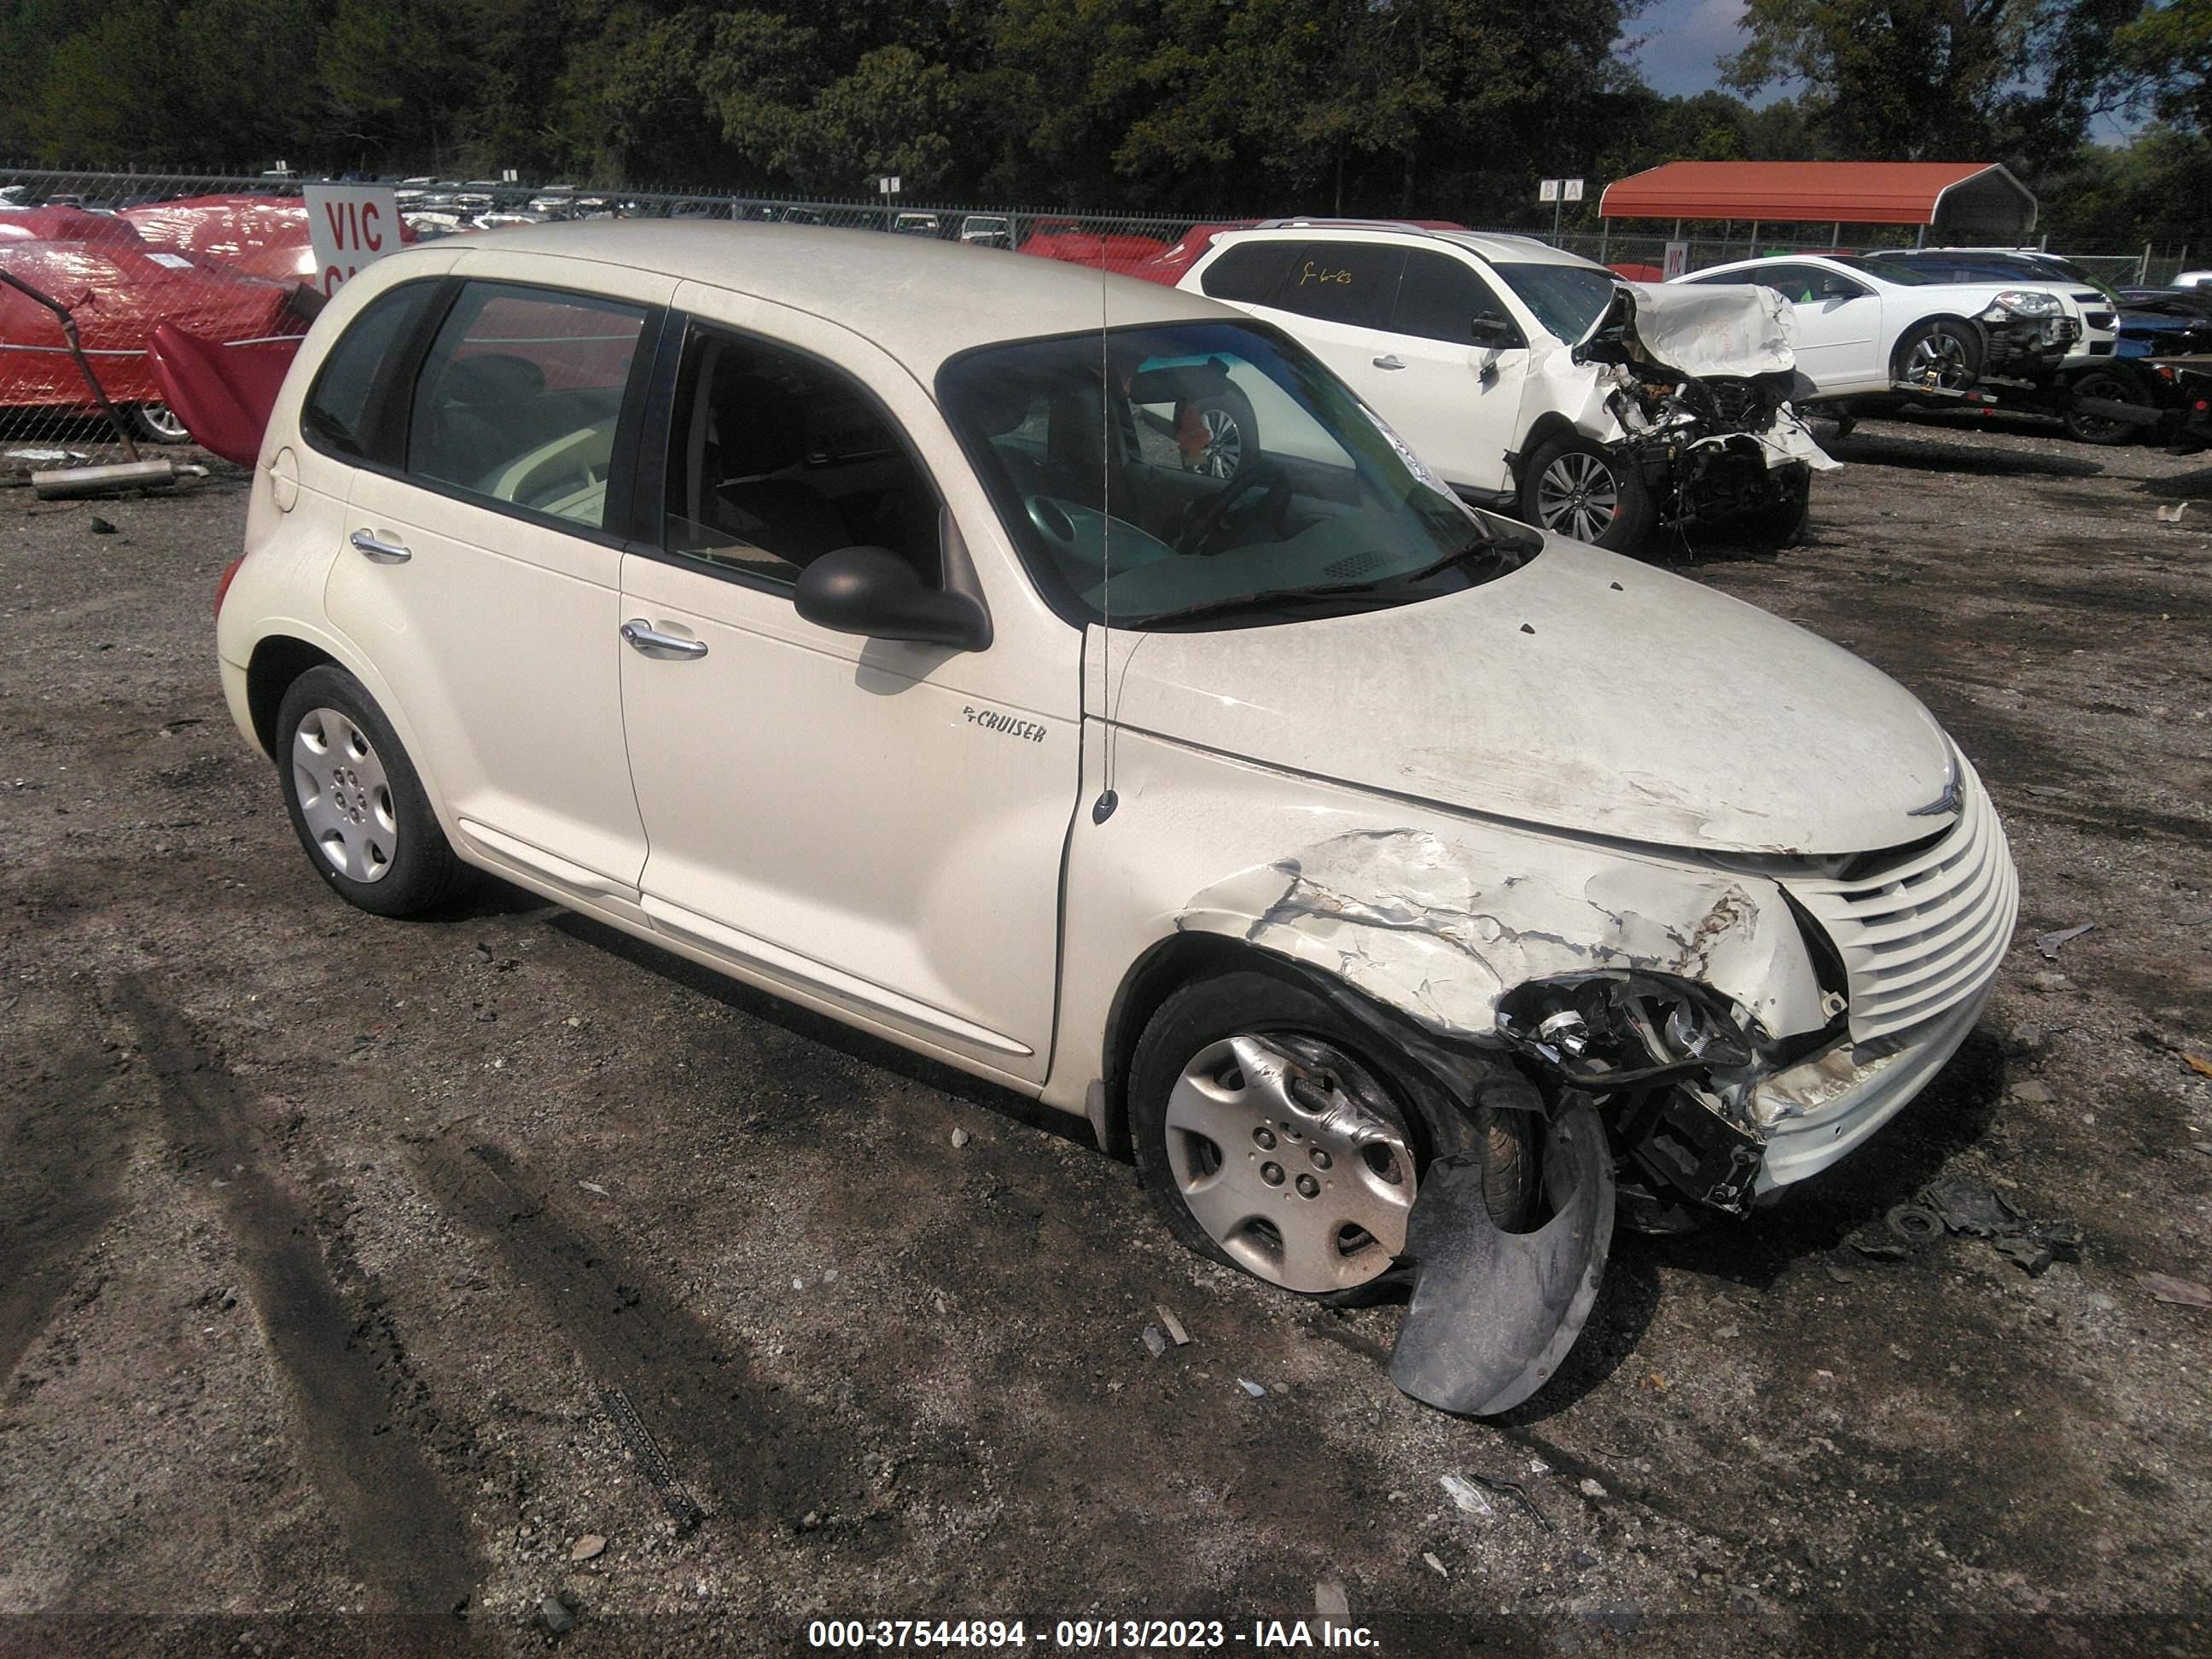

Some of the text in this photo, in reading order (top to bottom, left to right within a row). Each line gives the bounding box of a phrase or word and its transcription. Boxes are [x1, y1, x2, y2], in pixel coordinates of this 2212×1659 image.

[1545, 183, 1554, 198] B
[1567, 182, 1579, 198] A
[325, 201, 382, 252] VIC
[1669, 249, 1683, 274] VIC
[977, 710, 1047, 742] CRUISER
